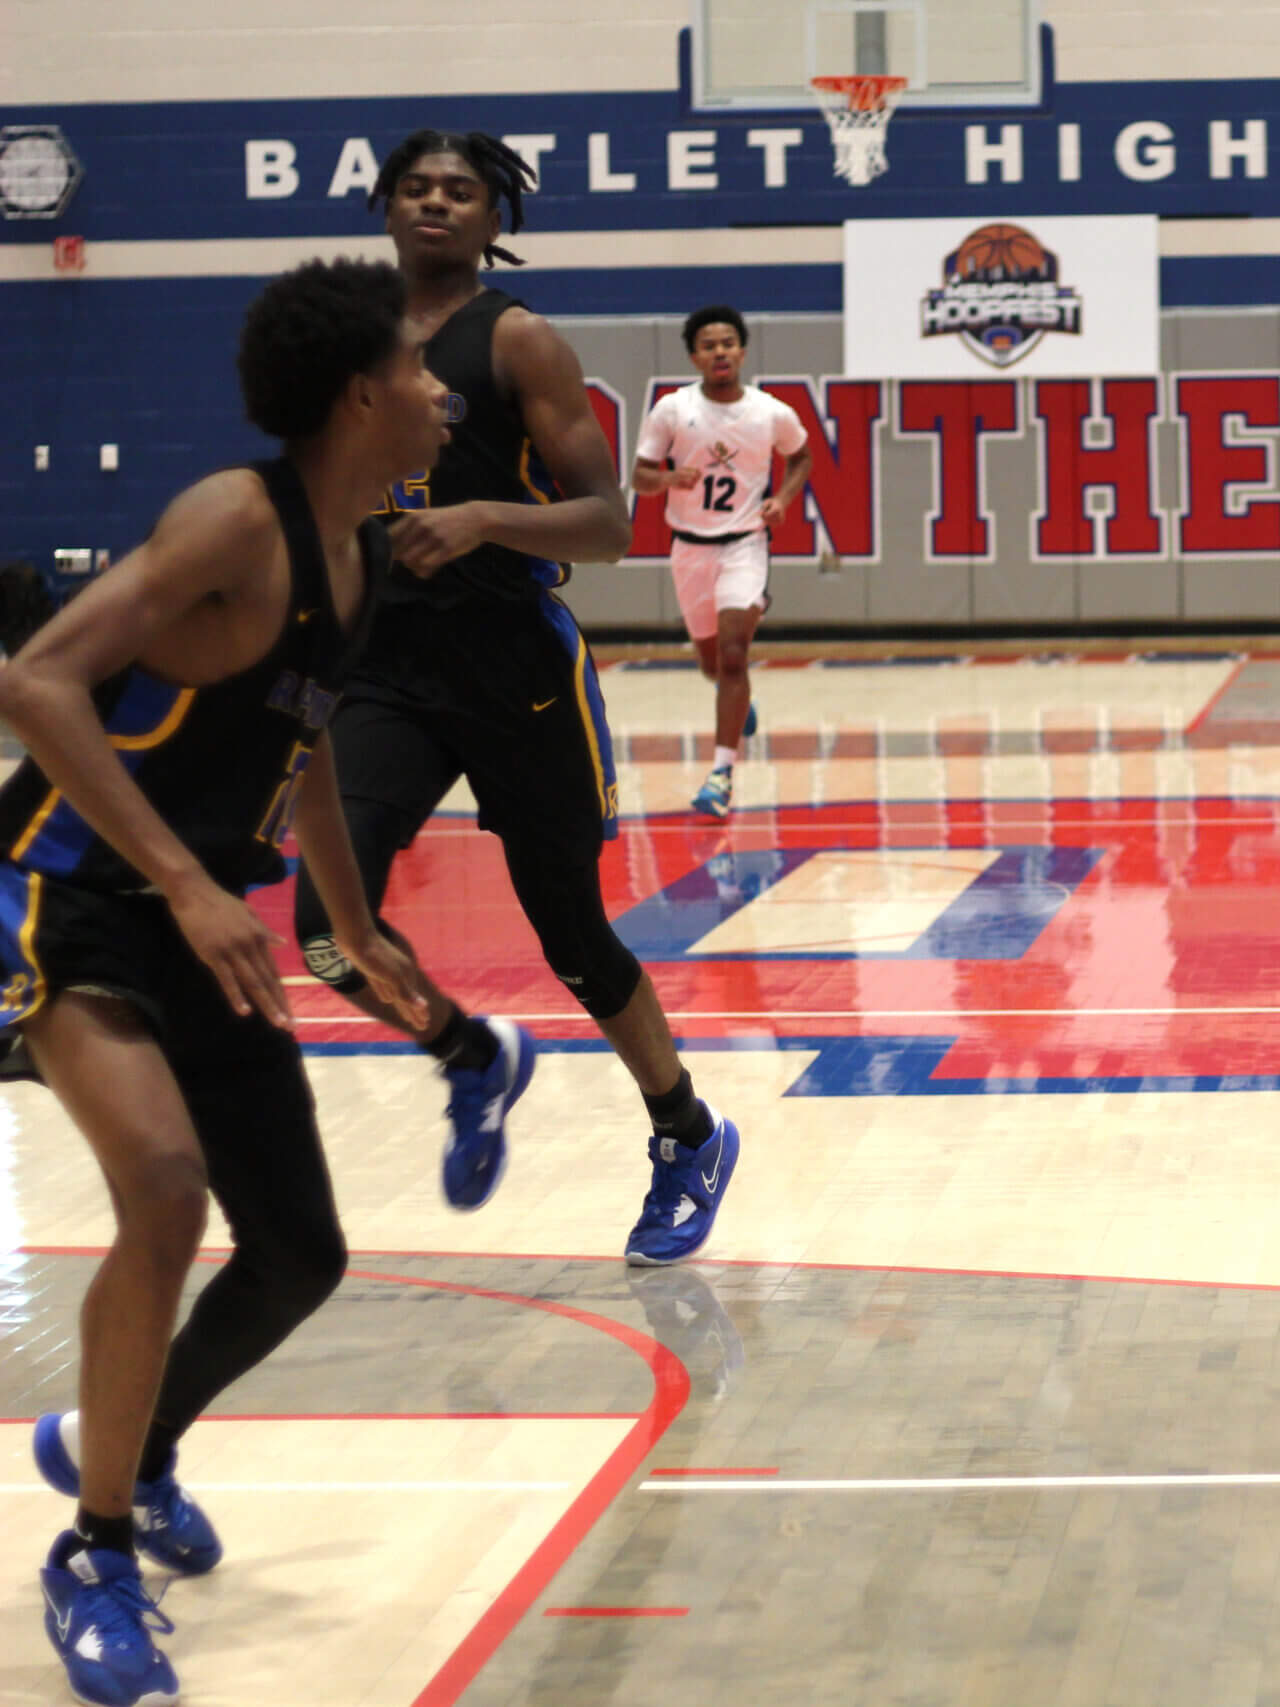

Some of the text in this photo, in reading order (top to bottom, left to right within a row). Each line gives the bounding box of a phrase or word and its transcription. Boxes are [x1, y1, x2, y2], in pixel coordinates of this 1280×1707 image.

[244, 126, 886, 199] BATLETT
[965, 119, 1268, 184] HIGH
[922, 296, 1081, 332] HOOPFEST
[703, 474, 736, 512] 12
